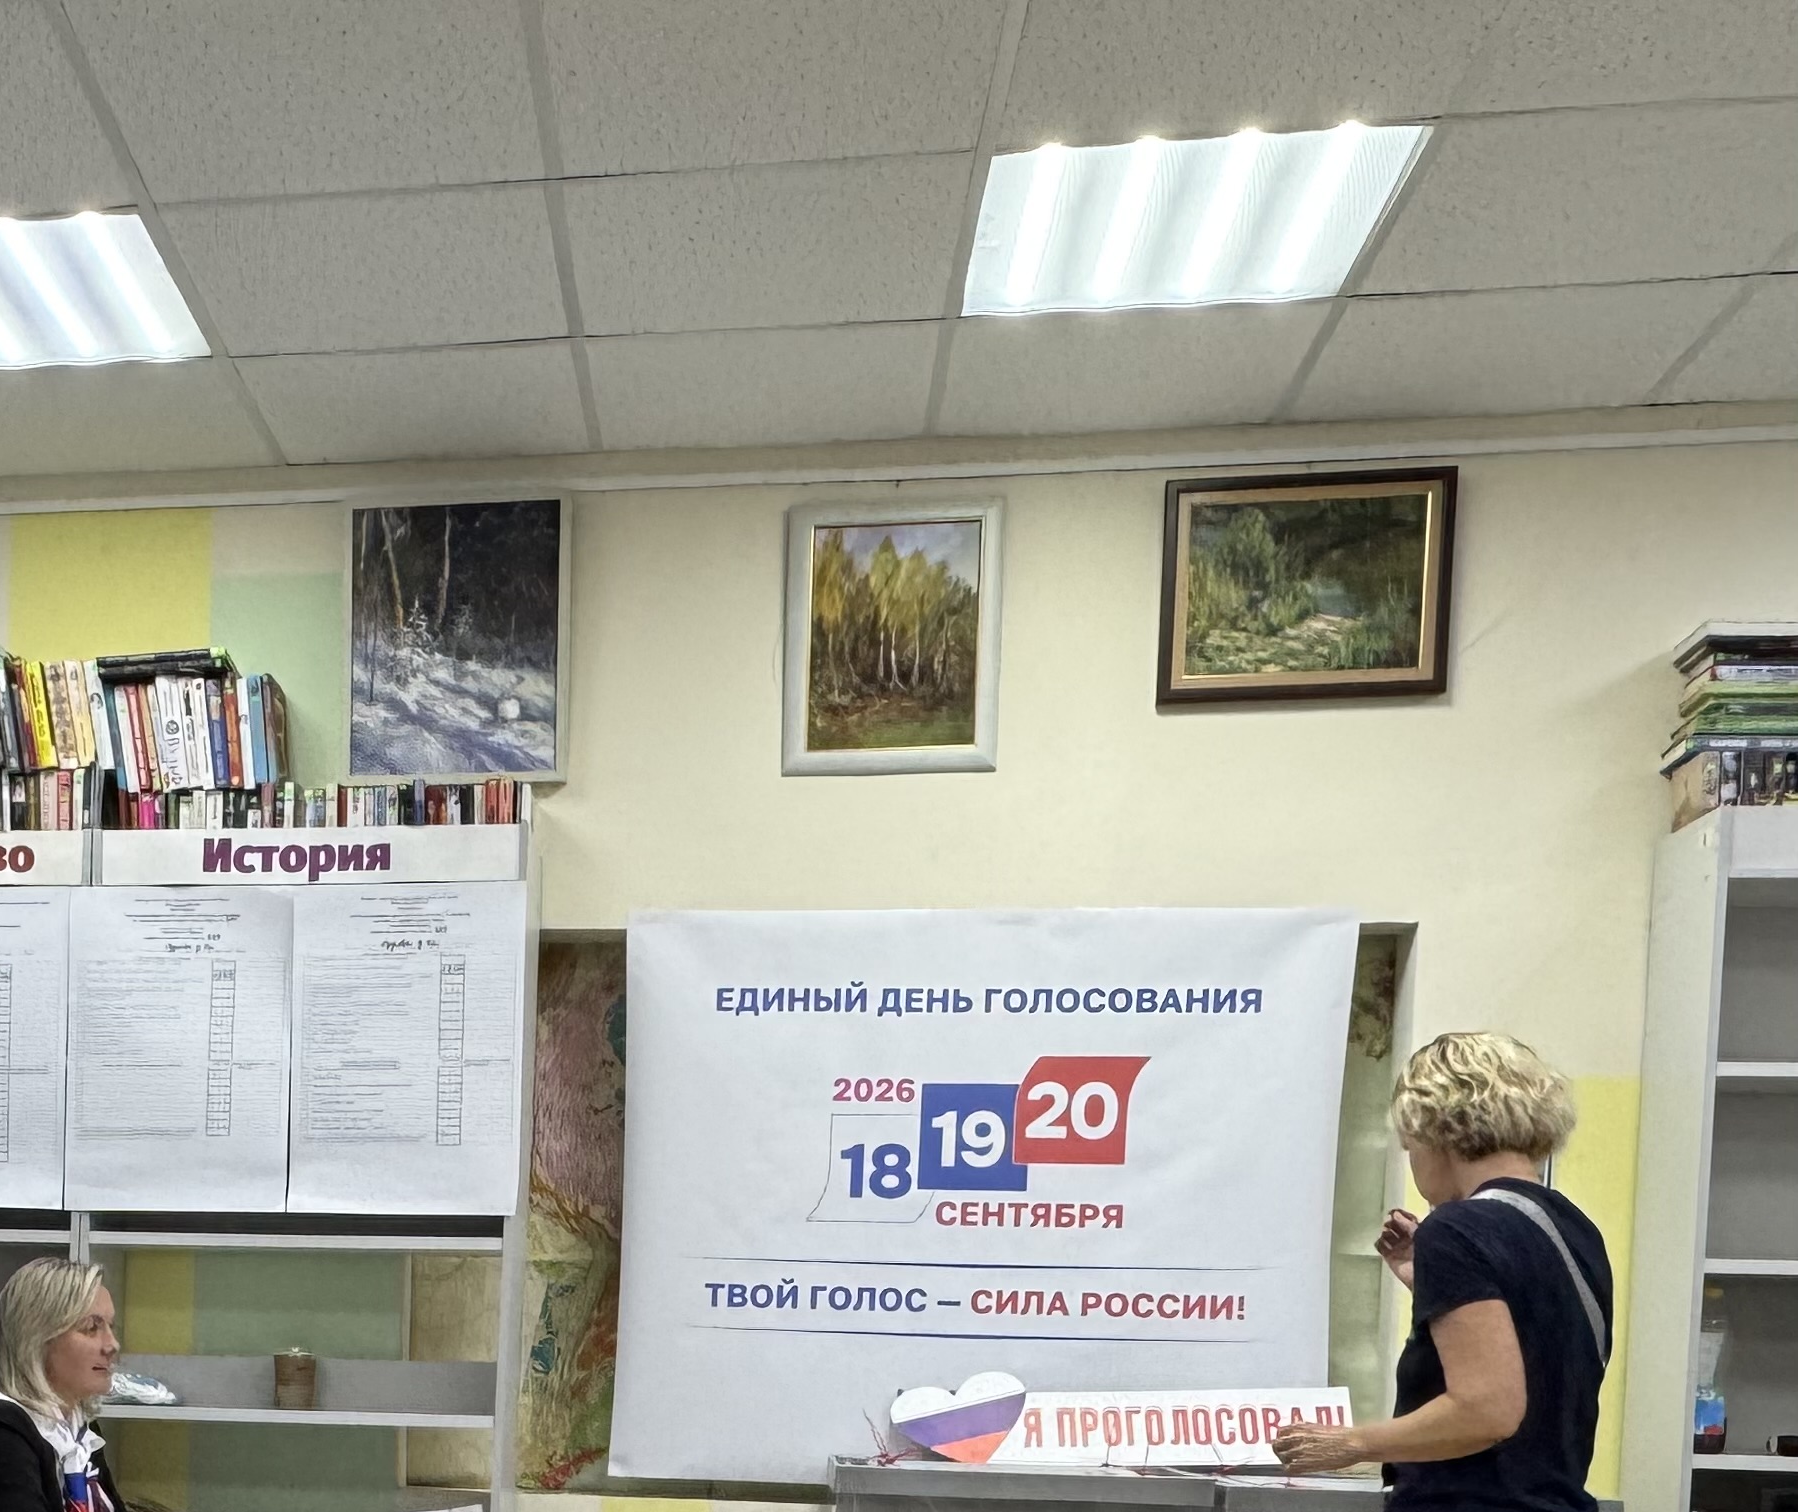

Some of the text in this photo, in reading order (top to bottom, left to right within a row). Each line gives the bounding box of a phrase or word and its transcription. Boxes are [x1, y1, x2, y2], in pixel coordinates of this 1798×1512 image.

[202, 837, 391, 883] История
[716, 981, 1264, 1018] ЕДИНЫЙ ДЕНЬ ГОЛОСОВАНИЯ
[832, 1077, 915, 1103] 2026
[840, 1080, 1119, 1200] 18 19 20
[935, 1201, 1124, 1229] СЕНТЯБРЯ
[704, 1278, 799, 1311] ТВОЙ
[810, 1286, 928, 1313] ГОЛОС
[970, 1289, 1070, 1317] СИЛА
[1081, 1291, 1245, 1321] РОССИИ!
[1024, 1407, 1043, 1449] Я
